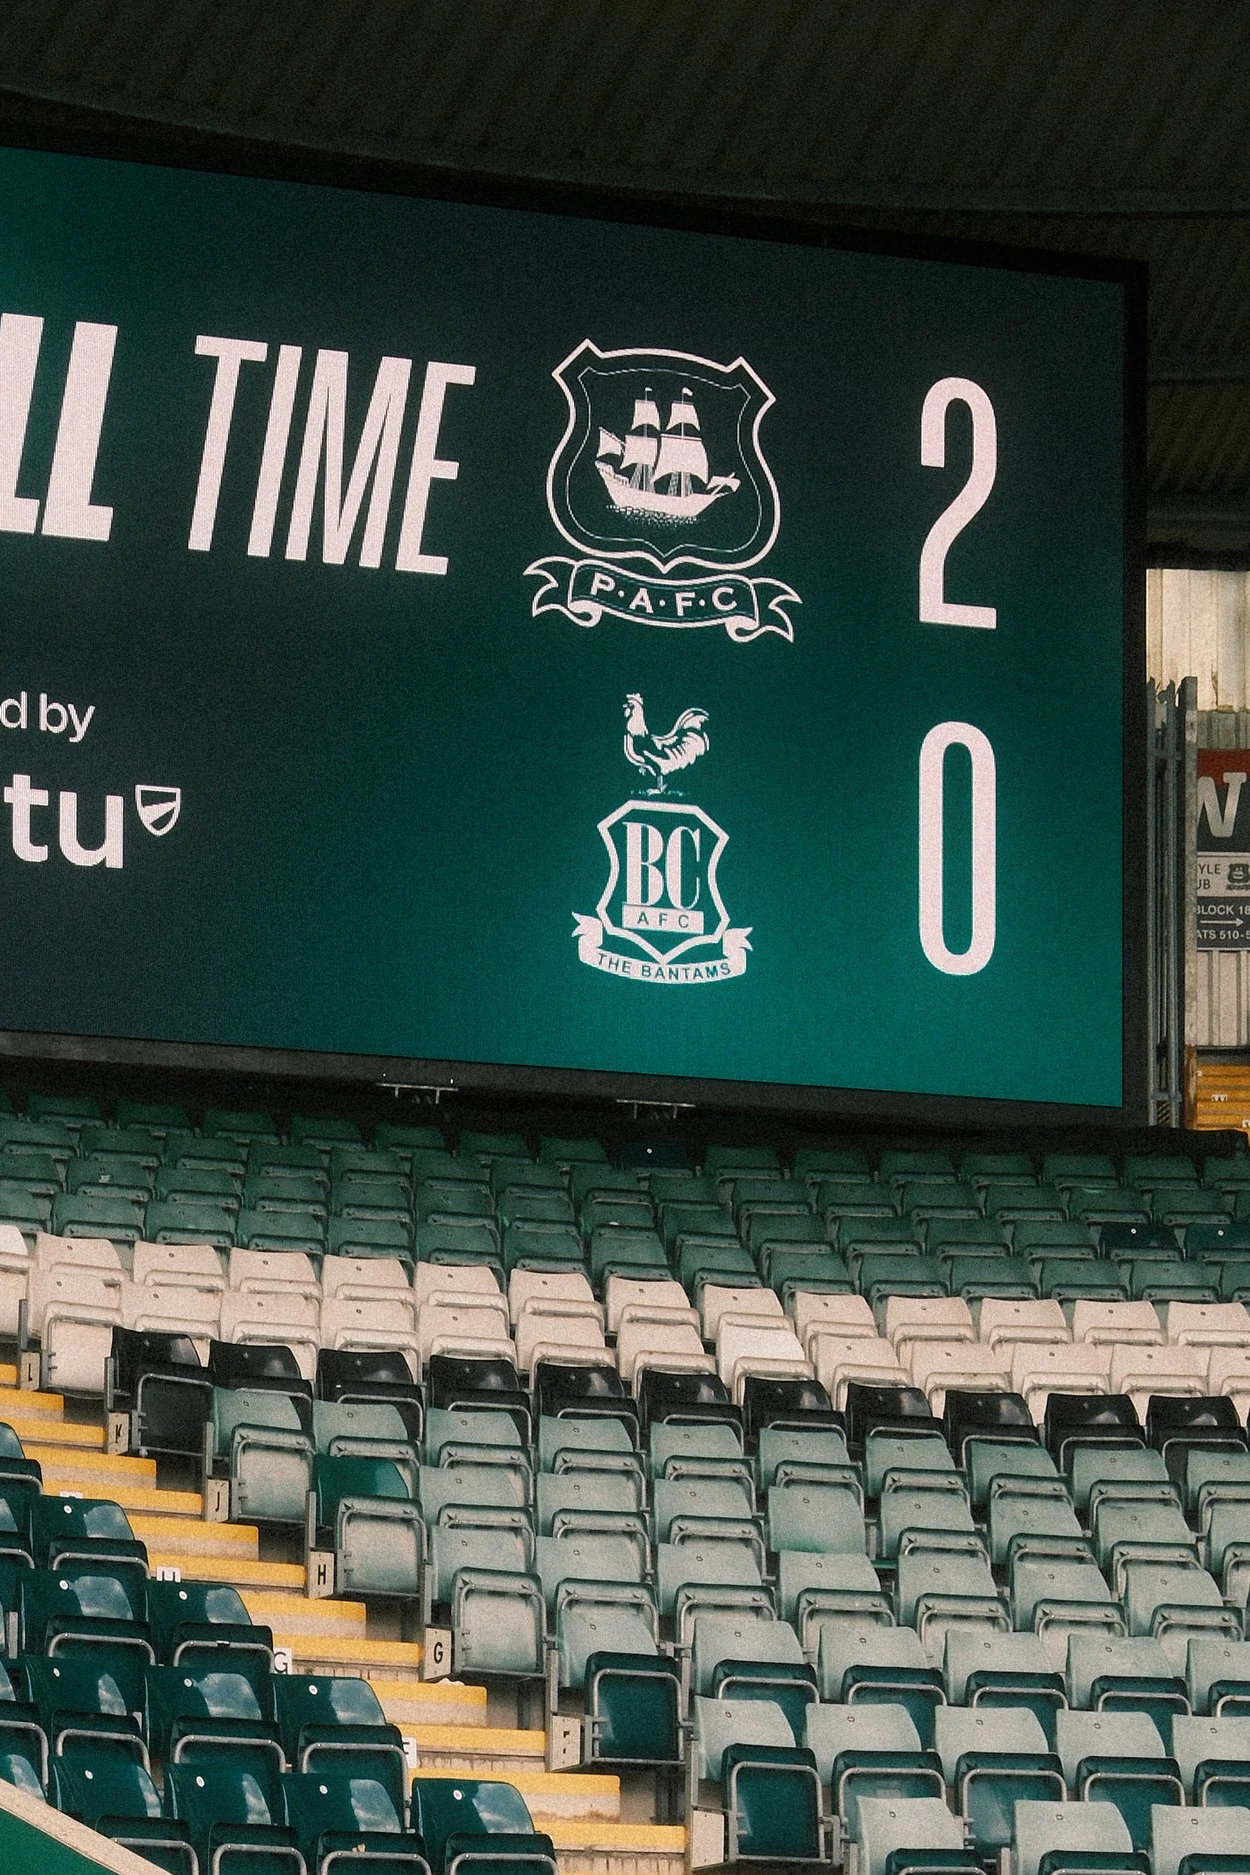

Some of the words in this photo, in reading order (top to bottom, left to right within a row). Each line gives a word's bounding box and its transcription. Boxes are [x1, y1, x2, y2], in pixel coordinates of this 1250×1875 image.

[188, 334, 476, 575] TIME
[918, 377, 999, 630] 2
[38, 692, 96, 742] by
[622, 821, 701, 910] BC
[918, 721, 998, 977] 0
[598, 952, 632, 974] THE
[641, 962, 732, 981] BANTAMS
[115, 1423, 123, 1444] K
[317, 1564, 327, 1585] H
[434, 1642, 444, 1664] G
